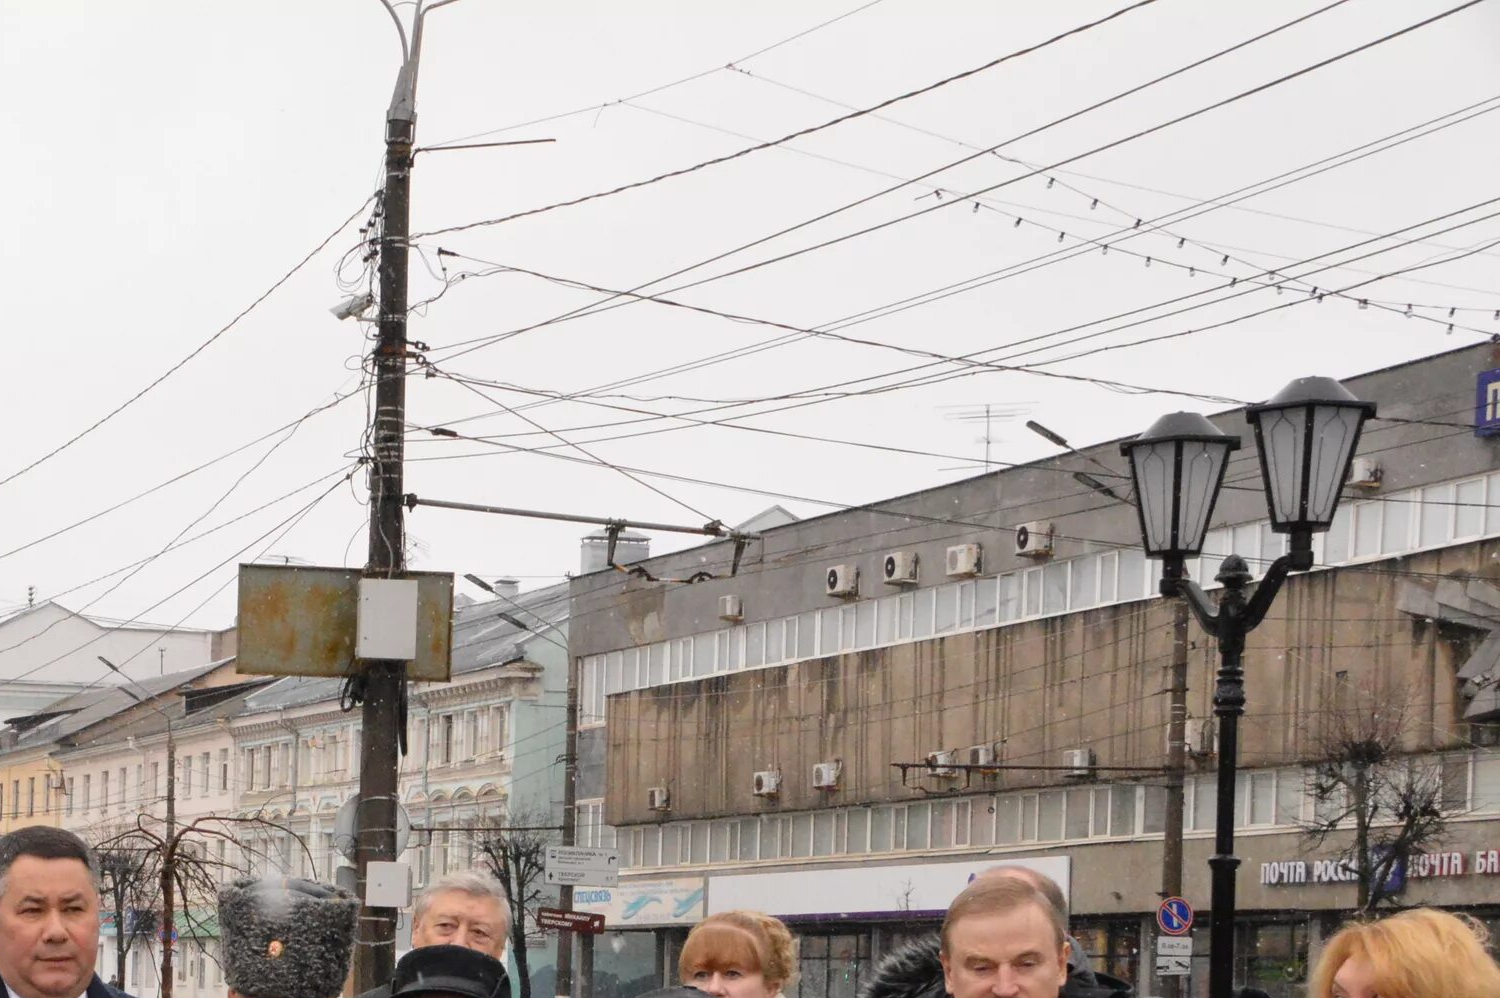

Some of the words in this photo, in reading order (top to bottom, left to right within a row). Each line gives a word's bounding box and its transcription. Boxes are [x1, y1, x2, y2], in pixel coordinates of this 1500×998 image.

[1260, 861, 1306, 884] ПОЧТА
[1313, 858, 1359, 882] РОССИ
[1406, 852, 1463, 877] ПОЧТА
[1475, 849, 1500, 874] БА
[574, 889, 612, 904] СПЕЦСВЯЗЬ
